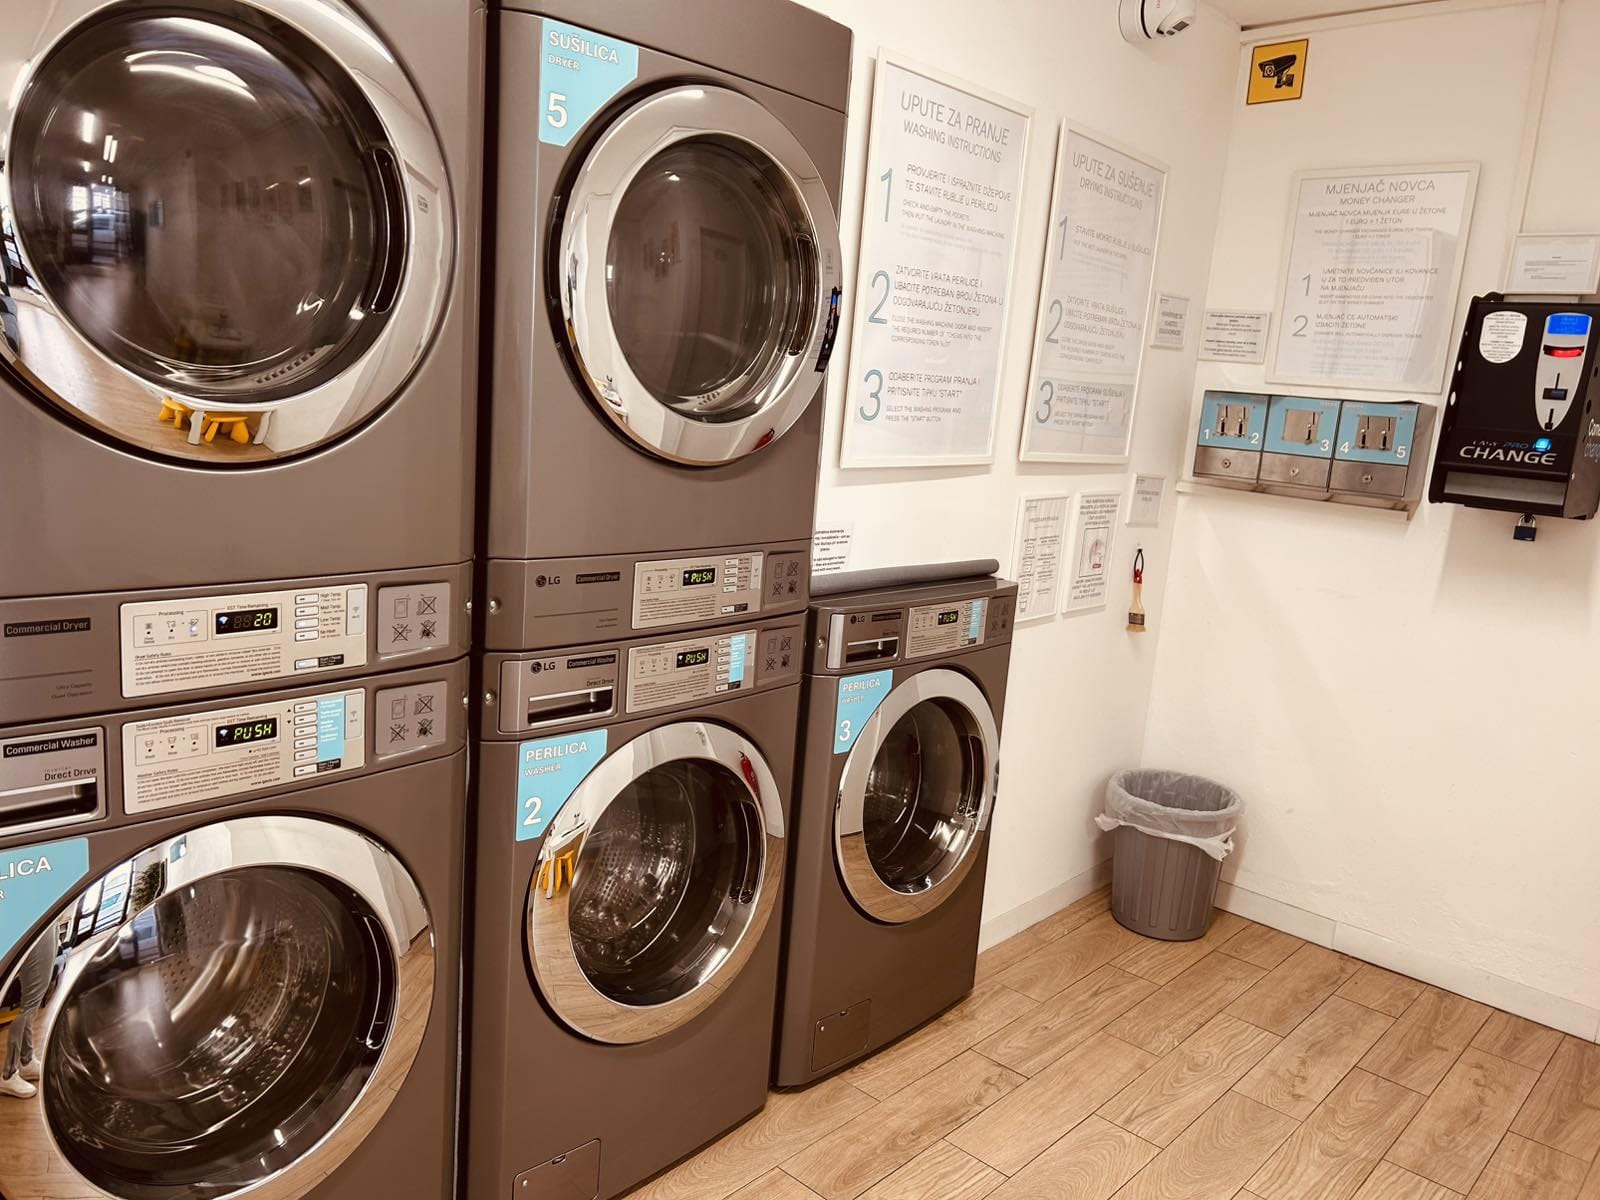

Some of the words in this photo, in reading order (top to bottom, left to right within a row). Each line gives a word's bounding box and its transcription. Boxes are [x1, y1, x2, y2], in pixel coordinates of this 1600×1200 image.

[549, 30, 619, 64] SUŠILICA
[548, 54, 581, 70] DRYER
[546, 91, 568, 129] 5
[901, 91, 945, 122] UPUTE
[947, 107, 962, 129] ZA
[965, 115, 1010, 146] PRANJE
[903, 120, 945, 144] WASHING
[947, 135, 1002, 163] INSTRUCTIONS
[906, 164, 948, 184] PROVJERITE
[950, 175, 982, 193] ISPRAZNITE
[982, 184, 1012, 202] DŽEPOVE
[1072, 152, 1104, 177] UPUTE
[1104, 164, 1116, 183] ZA
[1117, 169, 1154, 198] SUŠENJE
[880, 167, 892, 222] 1
[905, 179, 915, 190] TE
[915, 183, 942, 199] STAVITE
[964, 195, 971, 206] U
[970, 197, 998, 213] PERILICU
[1080, 176, 1104, 195] DRYING
[1104, 187, 1143, 210] INSTRUCTIONS
[1325, 179, 1385, 195] MJENJAČ
[1389, 179, 1435, 192] NOVCA
[1340, 196, 1371, 205] MONEY
[1372, 195, 1415, 204] CHANGER
[1418, 206, 1447, 214] ŽETONE
[1059, 215, 1068, 261] 1
[896, 264, 930, 280] ZATVORITE
[951, 275, 979, 288] PERILICE
[1301, 273, 1312, 296] 1
[868, 270, 891, 324] 2
[894, 281, 920, 294] UBACITE
[921, 284, 954, 298] POTREBAN
[956, 289, 973, 301] BROJ
[973, 290, 998, 304] ŽETONA
[1045, 299, 1063, 344] 2
[1292, 315, 1309, 338] 2
[888, 371, 923, 382] ODABERITE
[924, 373, 952, 384] PROGRAM
[953, 374, 977, 385] PRANJA
[859, 369, 883, 421] 3
[1036, 380, 1054, 424] 3
[1203, 429, 1210, 440] 1
[1250, 432, 1259, 444] 2
[1320, 439, 1329, 452] 3
[1340, 442, 1349, 453] 4
[1396, 446, 1406, 458] 5
[1459, 445, 1557, 466] CHANGE
[548, 576, 561, 585] LG
[690, 571, 713, 583] PUSH
[6, 622, 61, 635] Commercial
[63, 620, 88, 631] Dryer
[254, 612, 272, 627] 20
[544, 661, 556, 671] LG
[685, 652, 707, 664] PUSH
[843, 678, 881, 692] PERILICA
[234, 722, 273, 741] PUSH
[839, 720, 851, 741] 3
[6, 741, 59, 756] Commercial
[61, 736, 95, 749] Washer
[526, 741, 588, 763] PERILICA
[44, 770, 72, 781] Direct
[74, 767, 97, 778] Drive
[524, 763, 561, 777] WASHER
[523, 796, 543, 826] 2
